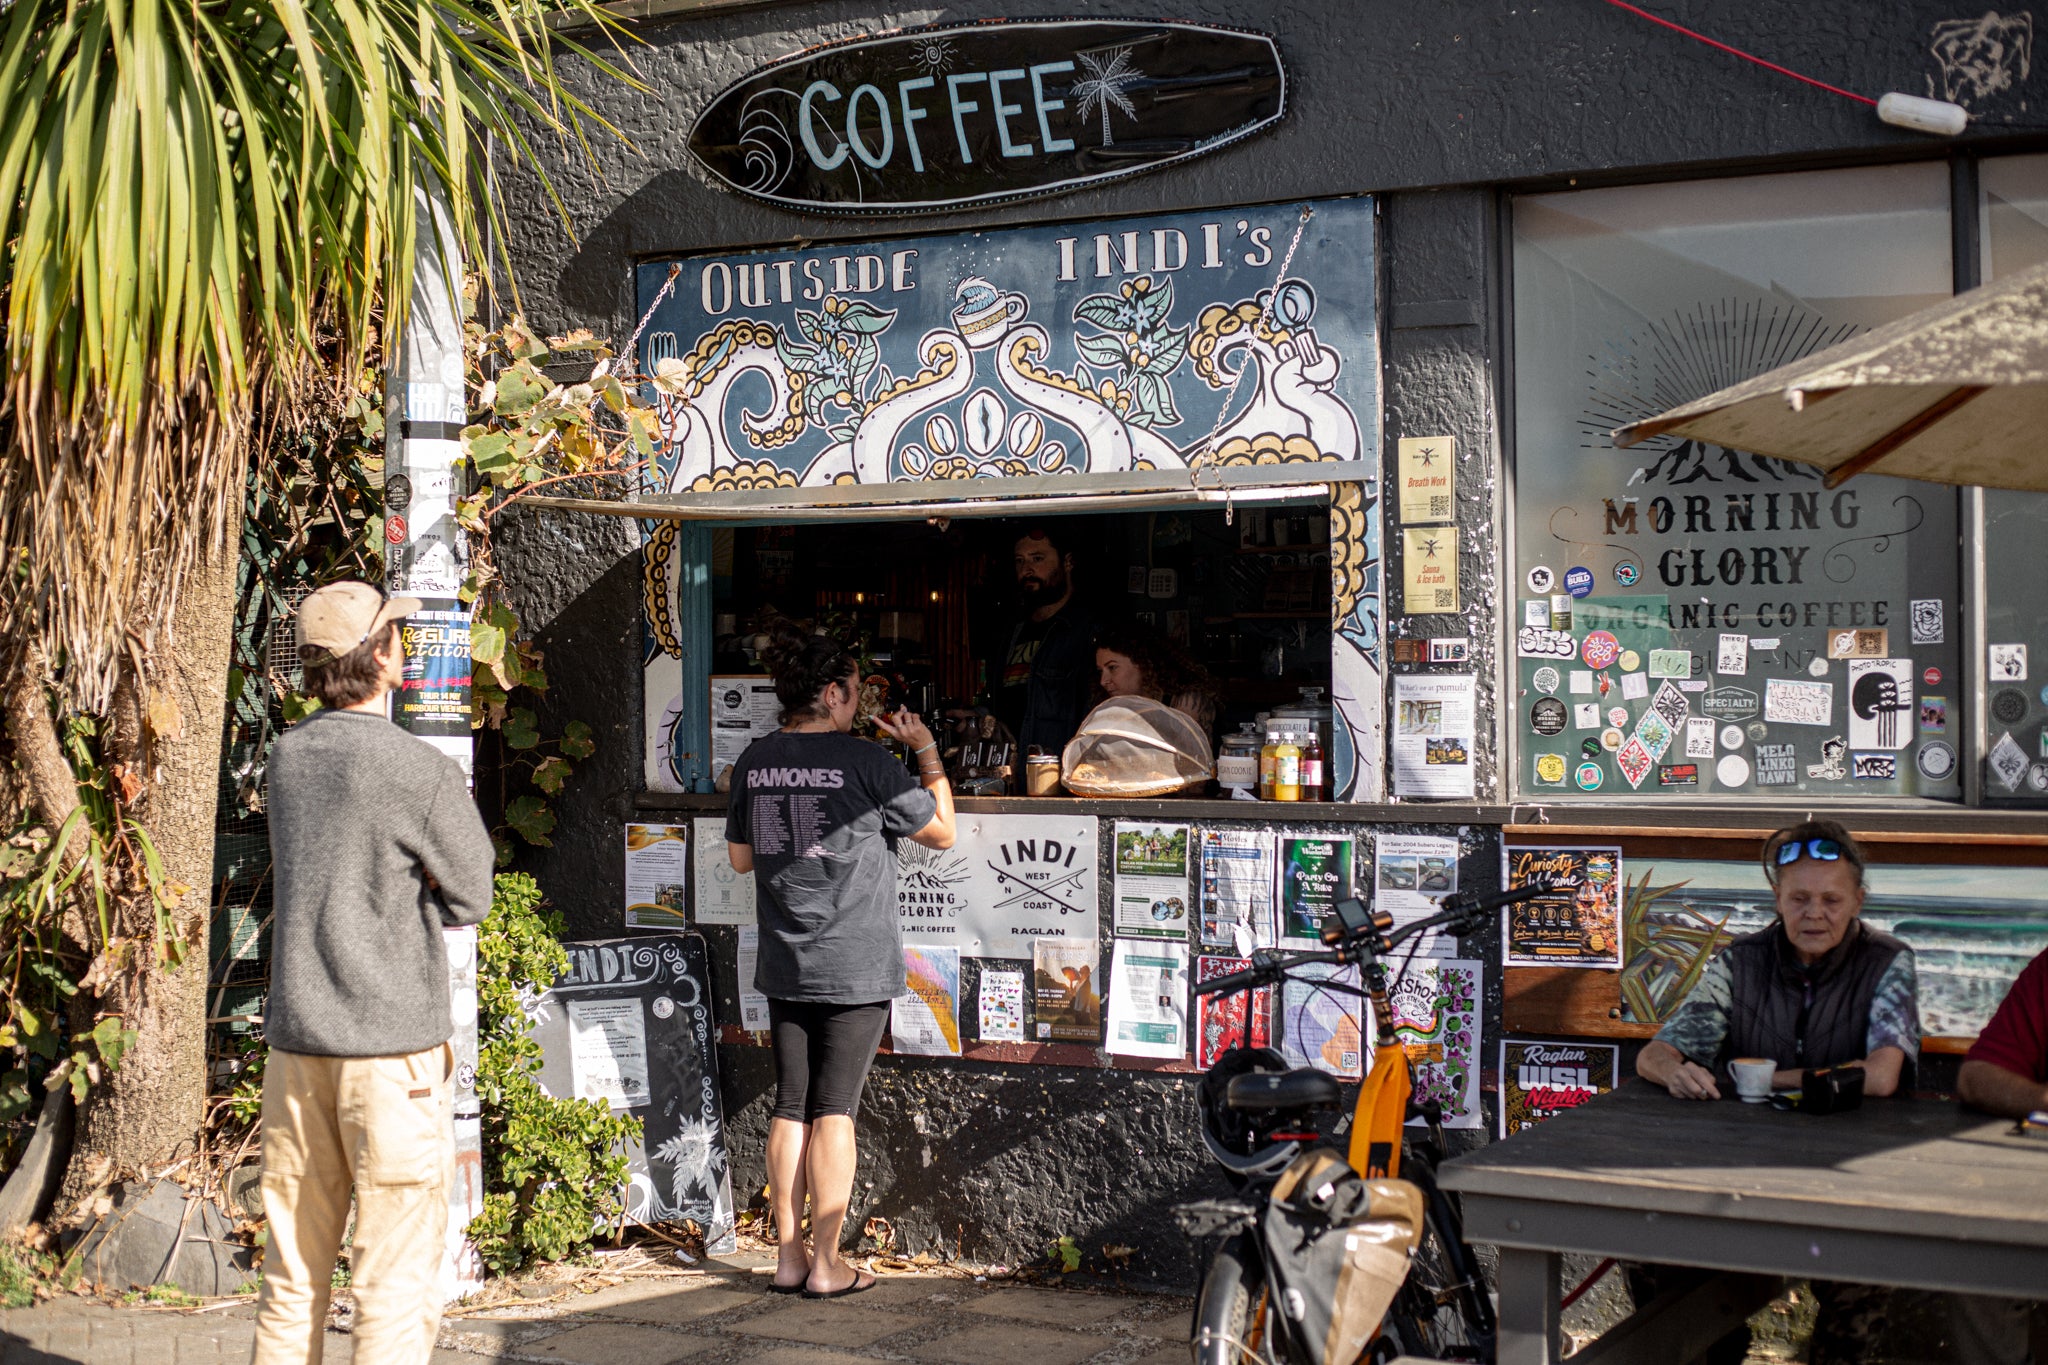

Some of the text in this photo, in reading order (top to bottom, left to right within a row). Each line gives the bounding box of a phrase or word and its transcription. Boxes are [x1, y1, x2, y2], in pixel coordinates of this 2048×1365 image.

[799, 60, 1076, 173] COFFEE
[700, 249, 919, 315] OUTSIDE
[1407, 475, 1447, 488] Breath Work
[1602, 489, 1861, 535] MORNING
[1422, 564, 1441, 574] Sauna
[1657, 546, 1810, 588] GLORY
[1431, 574, 1446, 584] bath
[1567, 574, 1591, 586] BUILD
[1583, 600, 1890, 630] ORGANIC COFFEE
[1435, 682, 1467, 693] pumula
[419, 691, 440, 701] THUR
[404, 703, 440, 714] HARBOUR
[440, 704, 456, 713] VIEW
[1704, 698, 1754, 708] SPECIALTY
[1610, 709, 1628, 718] VOTE
[1756, 745, 1795, 757] MELO
[1230, 766, 1253, 776] COOKIE
[1756, 771, 1796, 783] DAWN
[747, 767, 845, 789] RAMONES
[1222, 833, 1248, 843] Movies
[1000, 838, 1077, 868] INDI
[1518, 852, 1582, 878] Curiosity
[1025, 872, 1050, 880] WEST
[1296, 870, 1339, 882] Party On
[1004, 886, 1073, 898] N Z
[1301, 881, 1333, 892] A Bike
[898, 892, 955, 904] ORNING
[899, 905, 943, 917] GLORY
[1023, 901, 1053, 910] COAST
[1011, 927, 1065, 936] RAGLAN
[1036, 950, 1074, 961] TAYLOR
[563, 945, 637, 984] INDI
[1392, 996, 1404, 1006] FRI
[1523, 1044, 1588, 1066] Raglan
[1518, 1064, 1598, 1095] WSL
[1522, 1085, 1592, 1111] Nights
